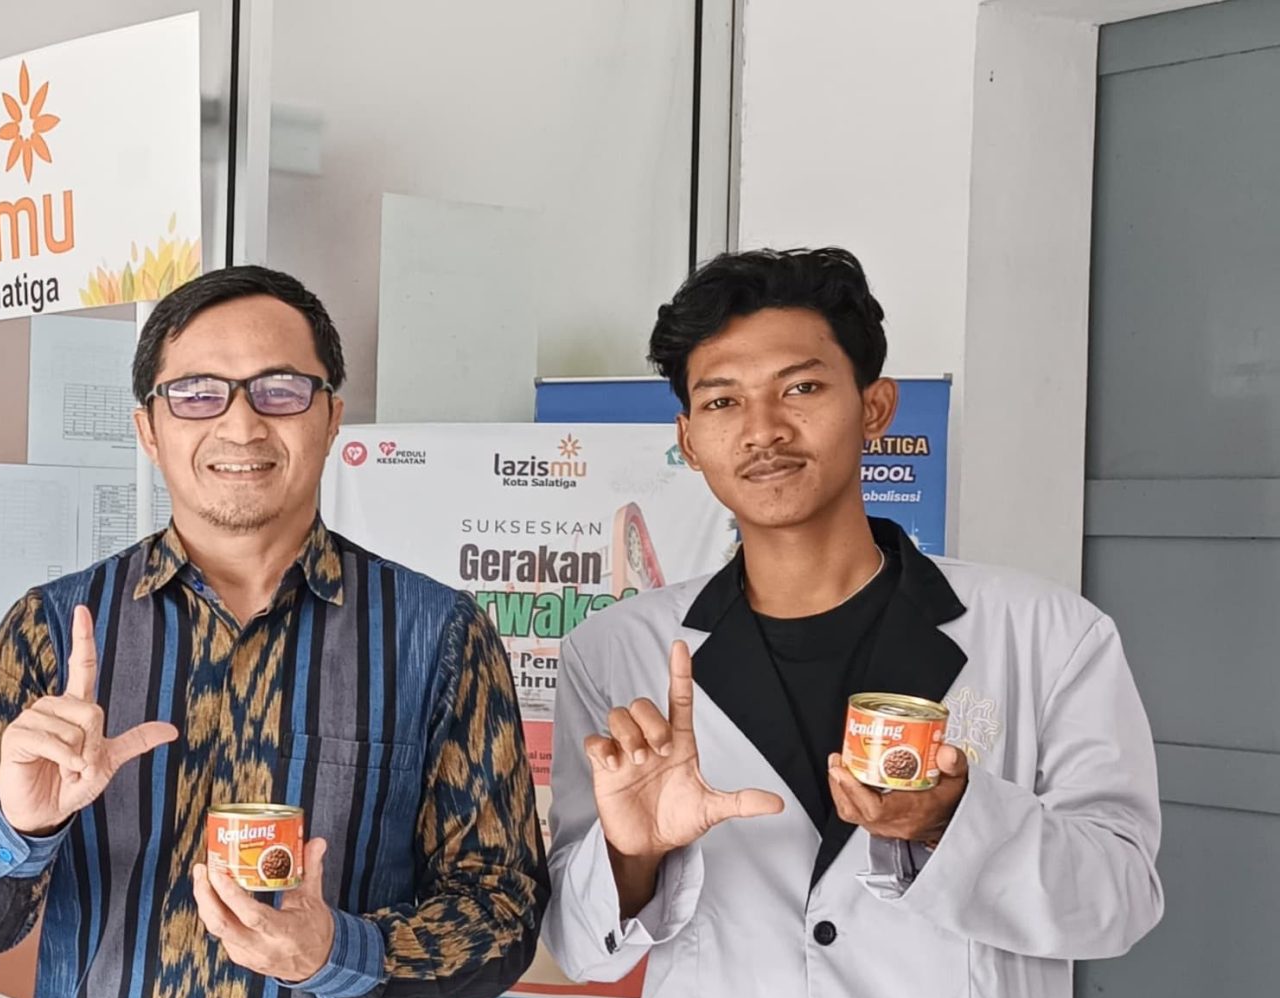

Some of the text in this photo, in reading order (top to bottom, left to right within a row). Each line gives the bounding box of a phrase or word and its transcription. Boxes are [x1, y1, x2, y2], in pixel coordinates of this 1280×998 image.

[377, 457, 426, 465] KESEHATAN
[494, 453, 587, 477] lazismu
[860, 466, 915, 481] HOOL
[503, 478, 577, 489] Kota Salatiga
[862, 490, 922, 502] obalisasi
[462, 519, 603, 535] SUKSESKAN
[460, 544, 602, 584] Gerakan
[520, 652, 558, 670] Pem
[216, 823, 277, 846] Rendang
